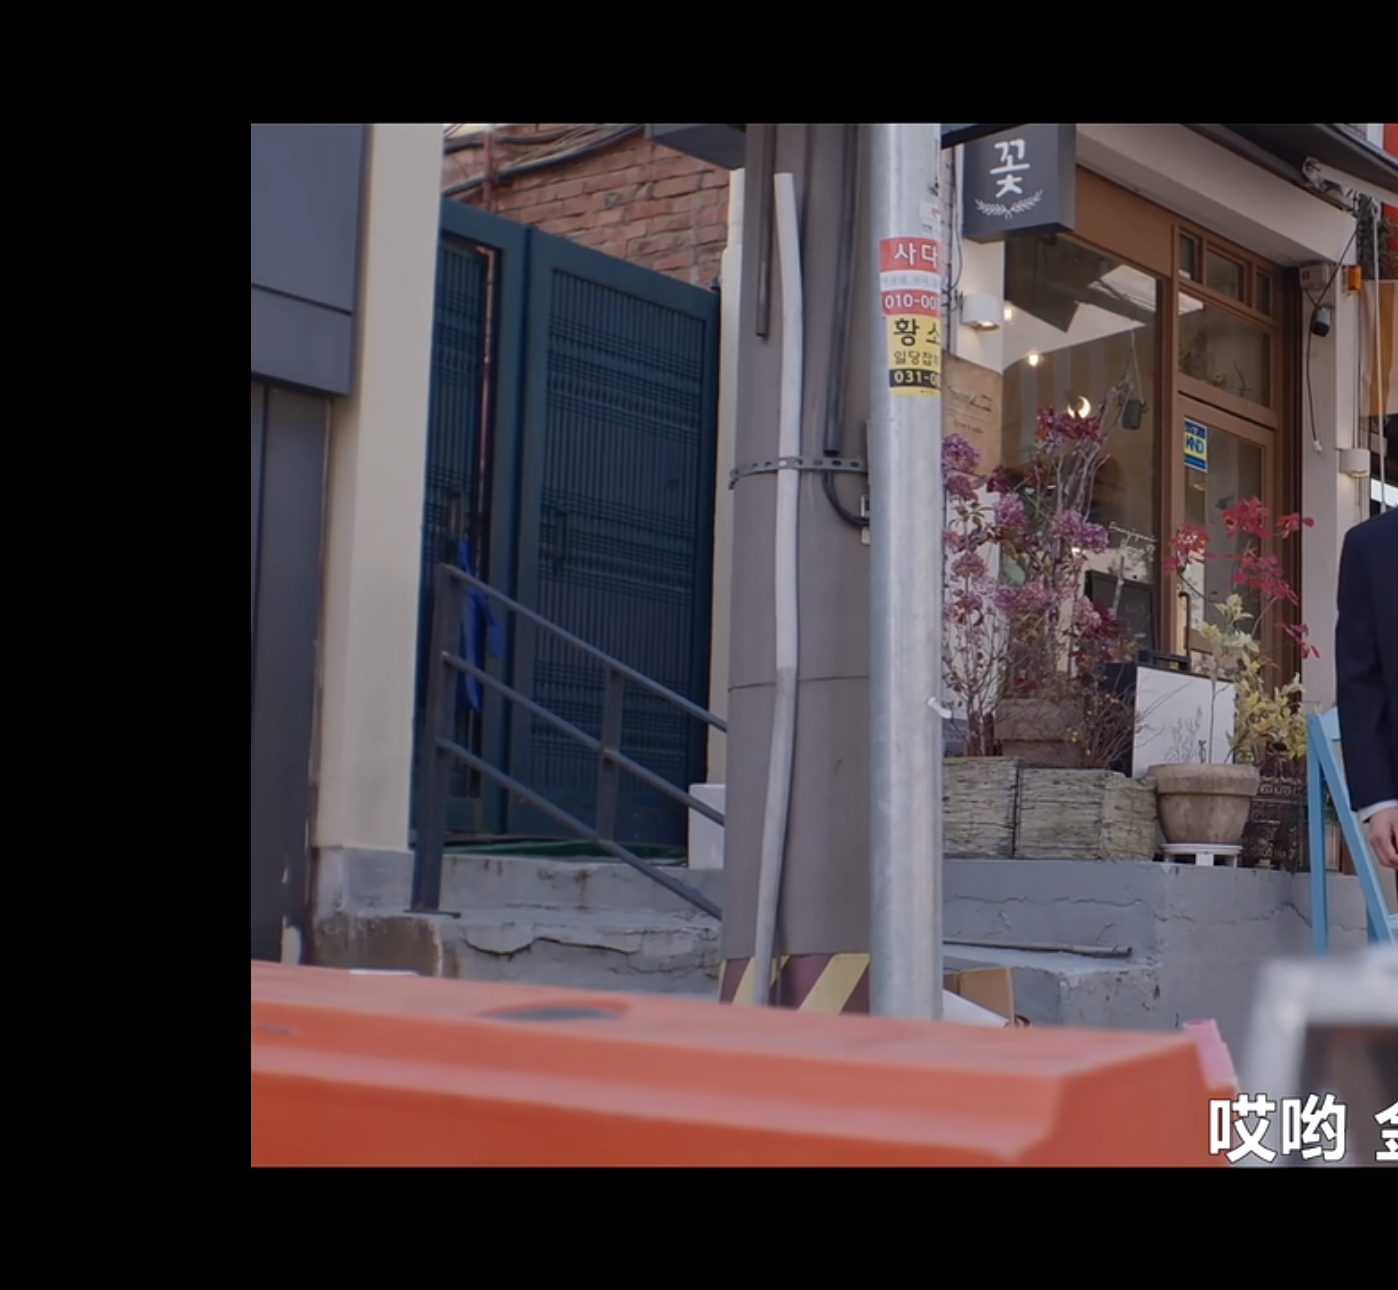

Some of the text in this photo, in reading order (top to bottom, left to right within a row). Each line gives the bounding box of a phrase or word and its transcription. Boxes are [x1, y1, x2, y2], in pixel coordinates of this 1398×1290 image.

[989, 138, 1031, 198] 꽃
[893, 350, 938, 367] 일당잡
[893, 370, 940, 386] 031-0
